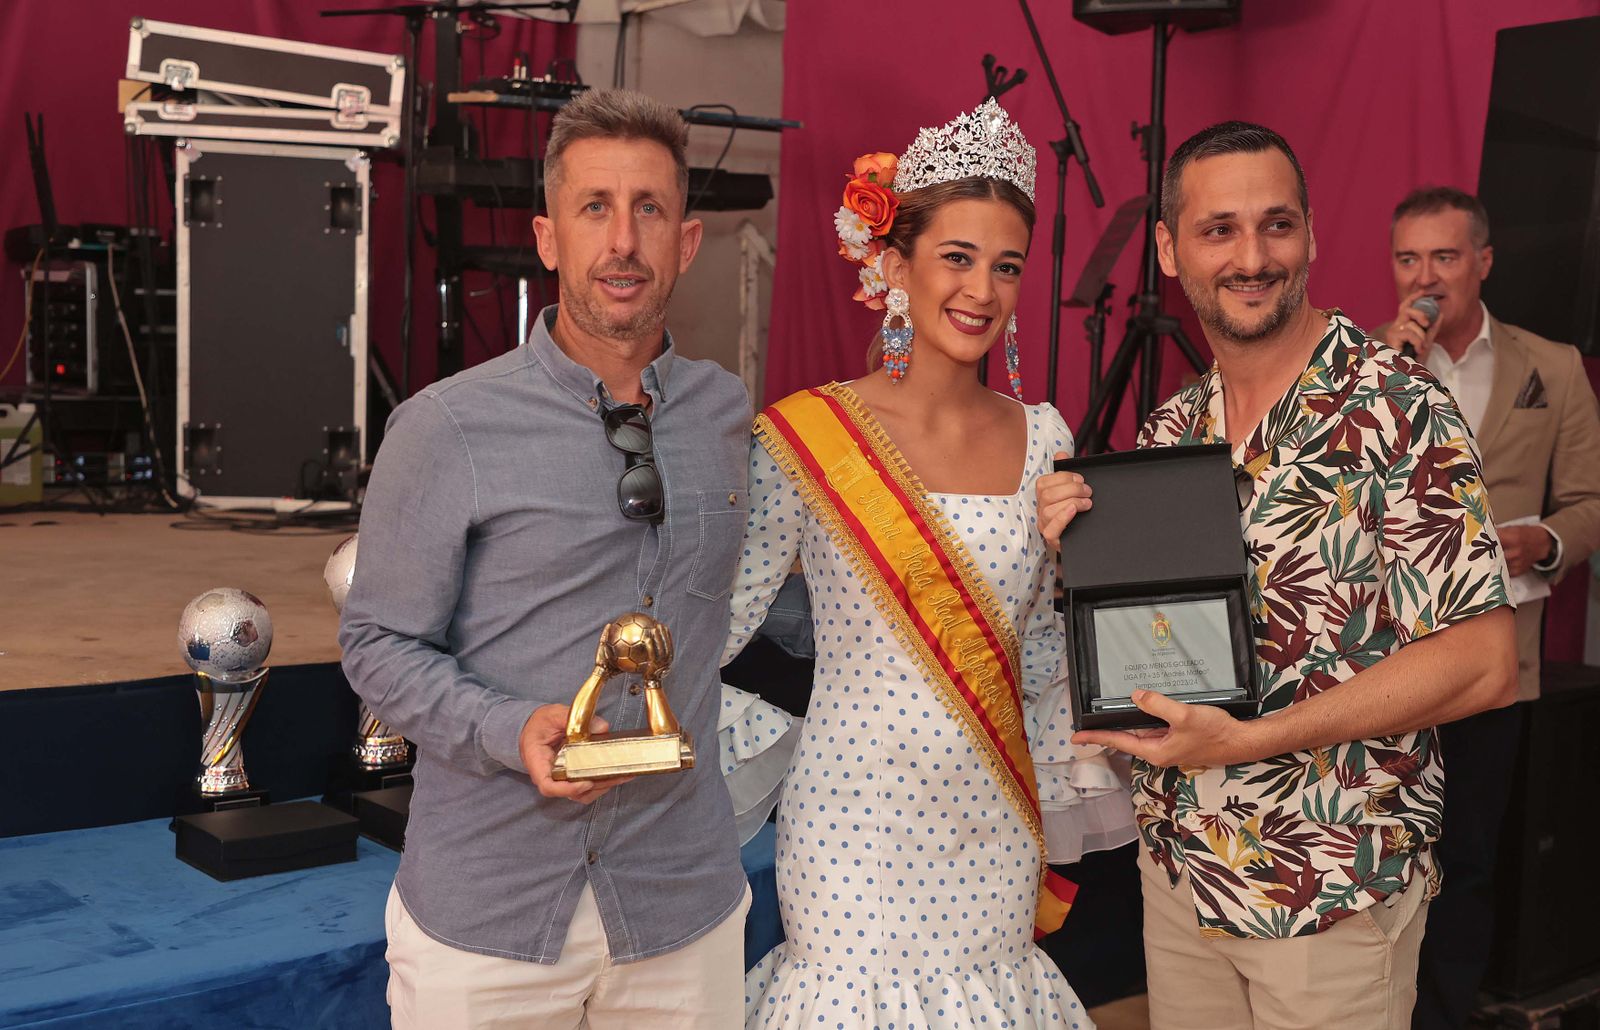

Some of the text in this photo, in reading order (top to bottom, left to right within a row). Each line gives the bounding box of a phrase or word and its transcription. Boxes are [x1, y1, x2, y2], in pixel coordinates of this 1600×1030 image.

[927, 588, 973, 633] Real
[953, 637, 1003, 705] Algeciras
[1124, 659, 1204, 672] EQUIPO MENOS GOLEADO
[1123, 672, 1138, 681] LIGA
[1135, 680, 1171, 689] Temporada
